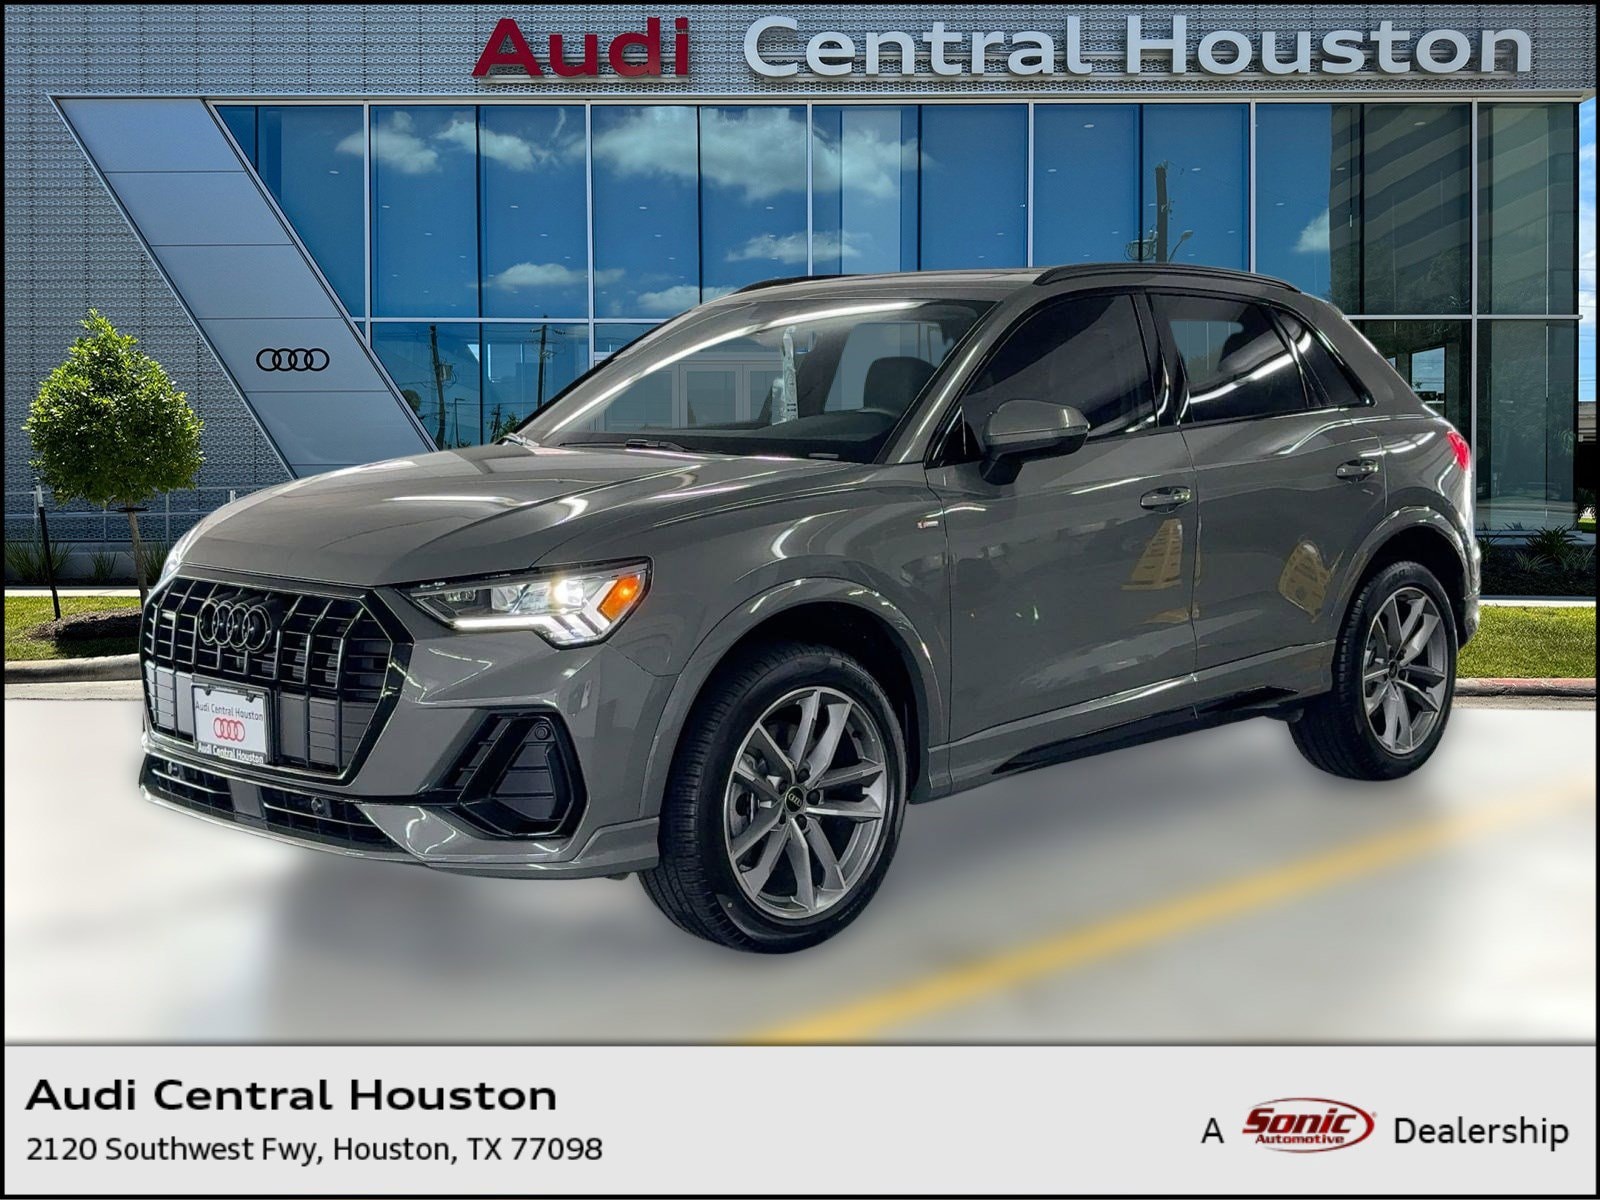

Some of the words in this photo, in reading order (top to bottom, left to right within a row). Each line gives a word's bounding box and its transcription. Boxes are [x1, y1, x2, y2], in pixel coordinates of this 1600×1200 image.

[472, 17, 689, 79] Audi
[743, 15, 1093, 77] Central
[1126, 15, 1532, 75] Houston
[195, 701, 210, 712] Audi
[211, 704, 234, 716] Central
[235, 708, 263, 720] Houston
[198, 742, 212, 754] Audi
[213, 745, 235, 759] Central
[236, 749, 264, 764] Houston
